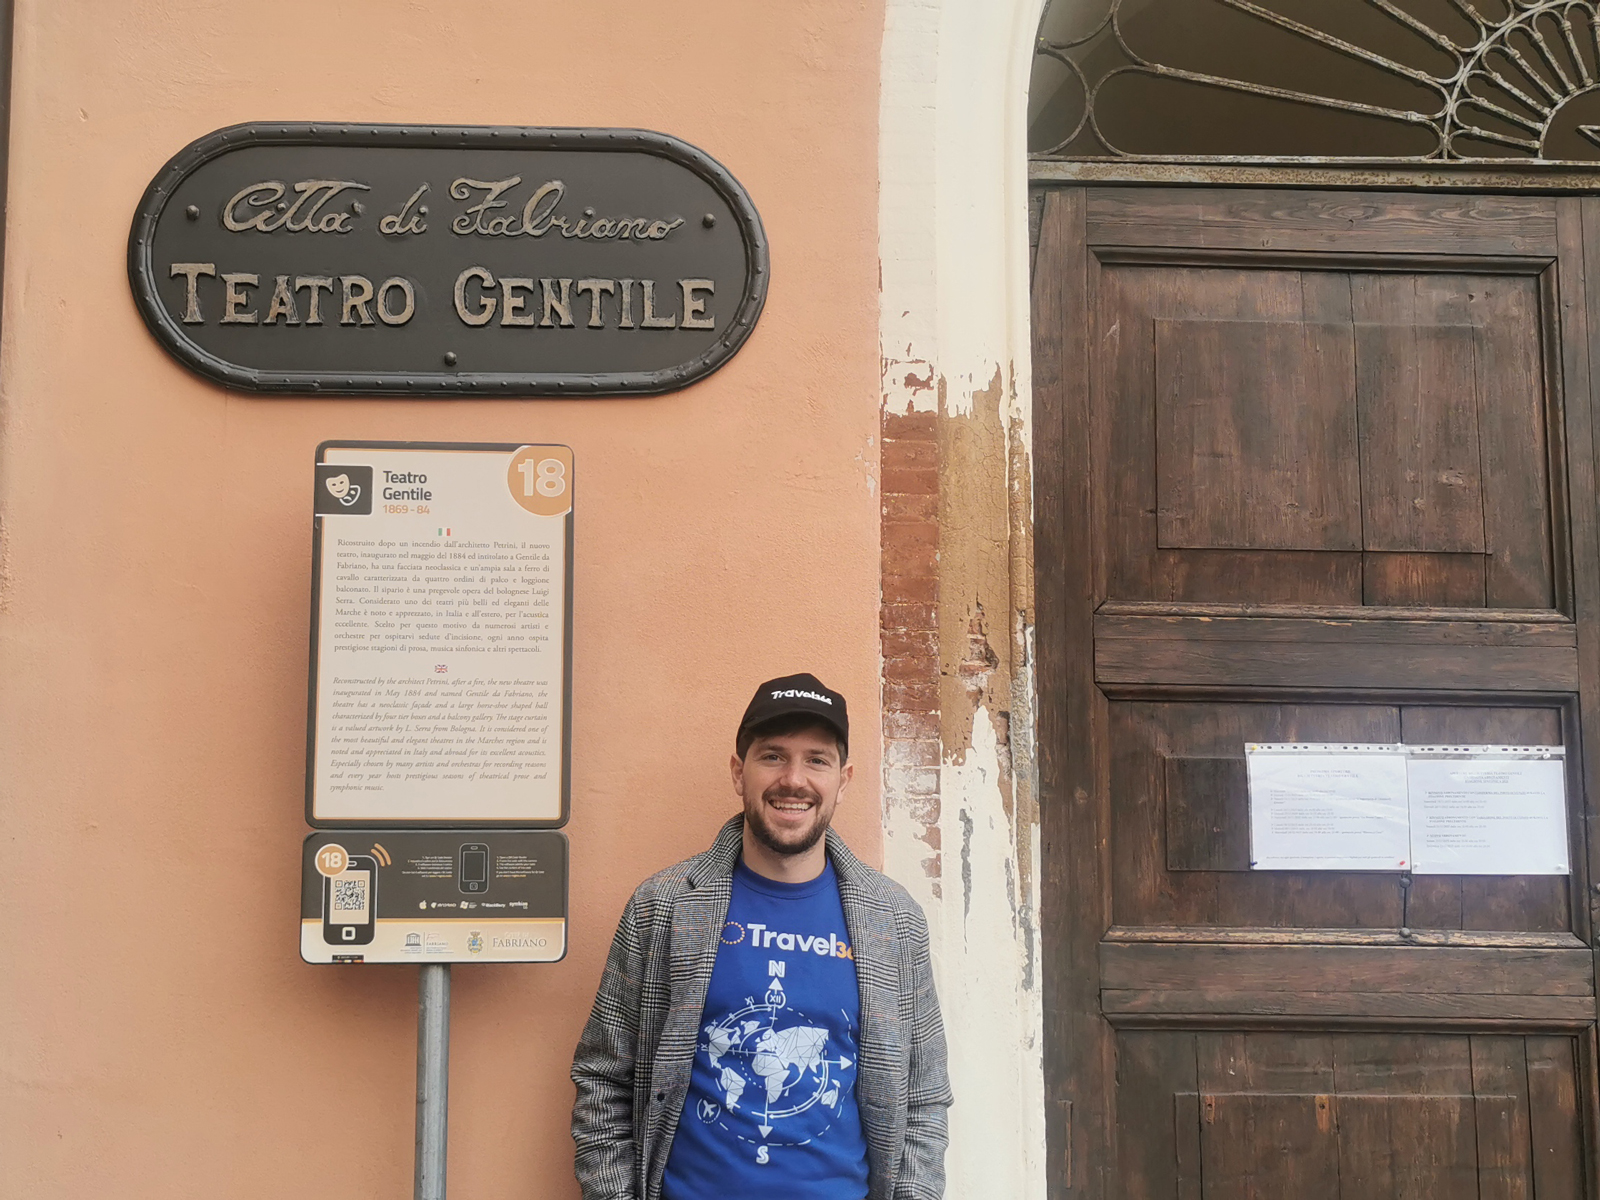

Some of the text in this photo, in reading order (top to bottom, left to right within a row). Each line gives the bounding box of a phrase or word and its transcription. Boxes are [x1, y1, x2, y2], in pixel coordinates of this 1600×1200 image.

[378, 181, 428, 235] di
[450, 175, 685, 240] Fabriano
[169, 262, 716, 329] TEATRO GENTILE
[383, 470, 428, 484] Teatro
[517, 458, 566, 498] 18
[382, 486, 433, 501] Gentile
[383, 504, 409, 514] 1869
[416, 505, 431, 515] 84
[337, 538, 376, 547] Ricostruito
[378, 539, 396, 549] dopo
[411, 540, 441, 548] incendio
[443, 540, 491, 549] dall'architetto
[493, 541, 518, 550] Petrini,
[360, 551, 398, 561] inaugurato
[398, 551, 409, 559] nel
[410, 552, 436, 562] maggio
[436, 551, 448, 560] del
[449, 552, 466, 560] 1884
[467, 552, 476, 560] ed
[477, 552, 509, 561] intitolato
[515, 552, 541, 561] Gentile
[336, 561, 369, 571] Fabriano,
[371, 562, 380, 570] ha
[397, 562, 423, 571] facciata
[424, 563, 462, 571] neoclassica
[470, 564, 502, 574] un'ampia
[503, 564, 516, 572] sala
[524, 564, 541, 572] ferro
[542, 564, 550, 573] di
[336, 573, 360, 581] cavallo
[411, 574, 421, 582] da
[424, 576, 450, 585] quattro
[490, 575, 509, 585] palco
[521, 576, 550, 586] loggione
[335, 584, 371, 593] balconato.
[373, 585, 379, 593] Il
[381, 586, 404, 596] sipario
[428, 586, 460, 596] pregevole
[483, 587, 494, 595] del
[496, 586, 530, 597] bolognese
[531, 587, 550, 598] Luigi
[335, 596, 356, 604] Serra.
[358, 596, 401, 605] Considerato
[421, 598, 433, 606] dei
[457, 598, 470, 608] più
[472, 598, 488, 606] belli
[491, 598, 500, 606] ed
[503, 598, 530, 609] eleganti
[532, 598, 550, 607] delle
[335, 608, 362, 616] Marche
[395, 611, 433, 619] apprezzato,
[445, 609, 463, 618] Italia
[471, 609, 503, 618] all'estero,
[518, 610, 550, 619] l'acustica
[334, 619, 370, 628] eccellente.
[374, 620, 396, 629] Scelto
[399, 622, 412, 631] per
[415, 623, 438, 631] questo
[471, 621, 481, 629] da
[334, 631, 366, 640] orchestre
[369, 634, 381, 642] per
[384, 632, 415, 642] ospitarvi
[418, 632, 441, 641] sedute
[444, 632, 483, 642] d'incisione,
[487, 634, 503, 643] ogni
[528, 634, 549, 644] ospita
[334, 643, 370, 653] prestigiose
[370, 644, 398, 654] stagioni
[399, 643, 407, 652] di
[455, 644, 486, 653] sinfonica
[492, 644, 507, 653] altri
[508, 645, 542, 655] spettacoli.
[384, 689, 401, 699] May
[404, 689, 422, 697] 1884
[440, 689, 464, 697] named
[465, 689, 490, 698] Gentile
[492, 689, 501, 697] da
[503, 689, 534, 698] Fabriano,
[537, 690, 549, 698] the
[363, 759, 384, 767] chosen
[436, 760, 451, 768] and
[481, 760, 493, 770] for
[493, 760, 524, 770] recording
[329, 771, 345, 779] and
[512, 774, 530, 782] prose
[533, 772, 548, 780] and
[321, 851, 343, 868] 18
[492, 937, 547, 948] FABRIANO
[768, 960, 785, 978] N
[756, 1146, 769, 1164] S
